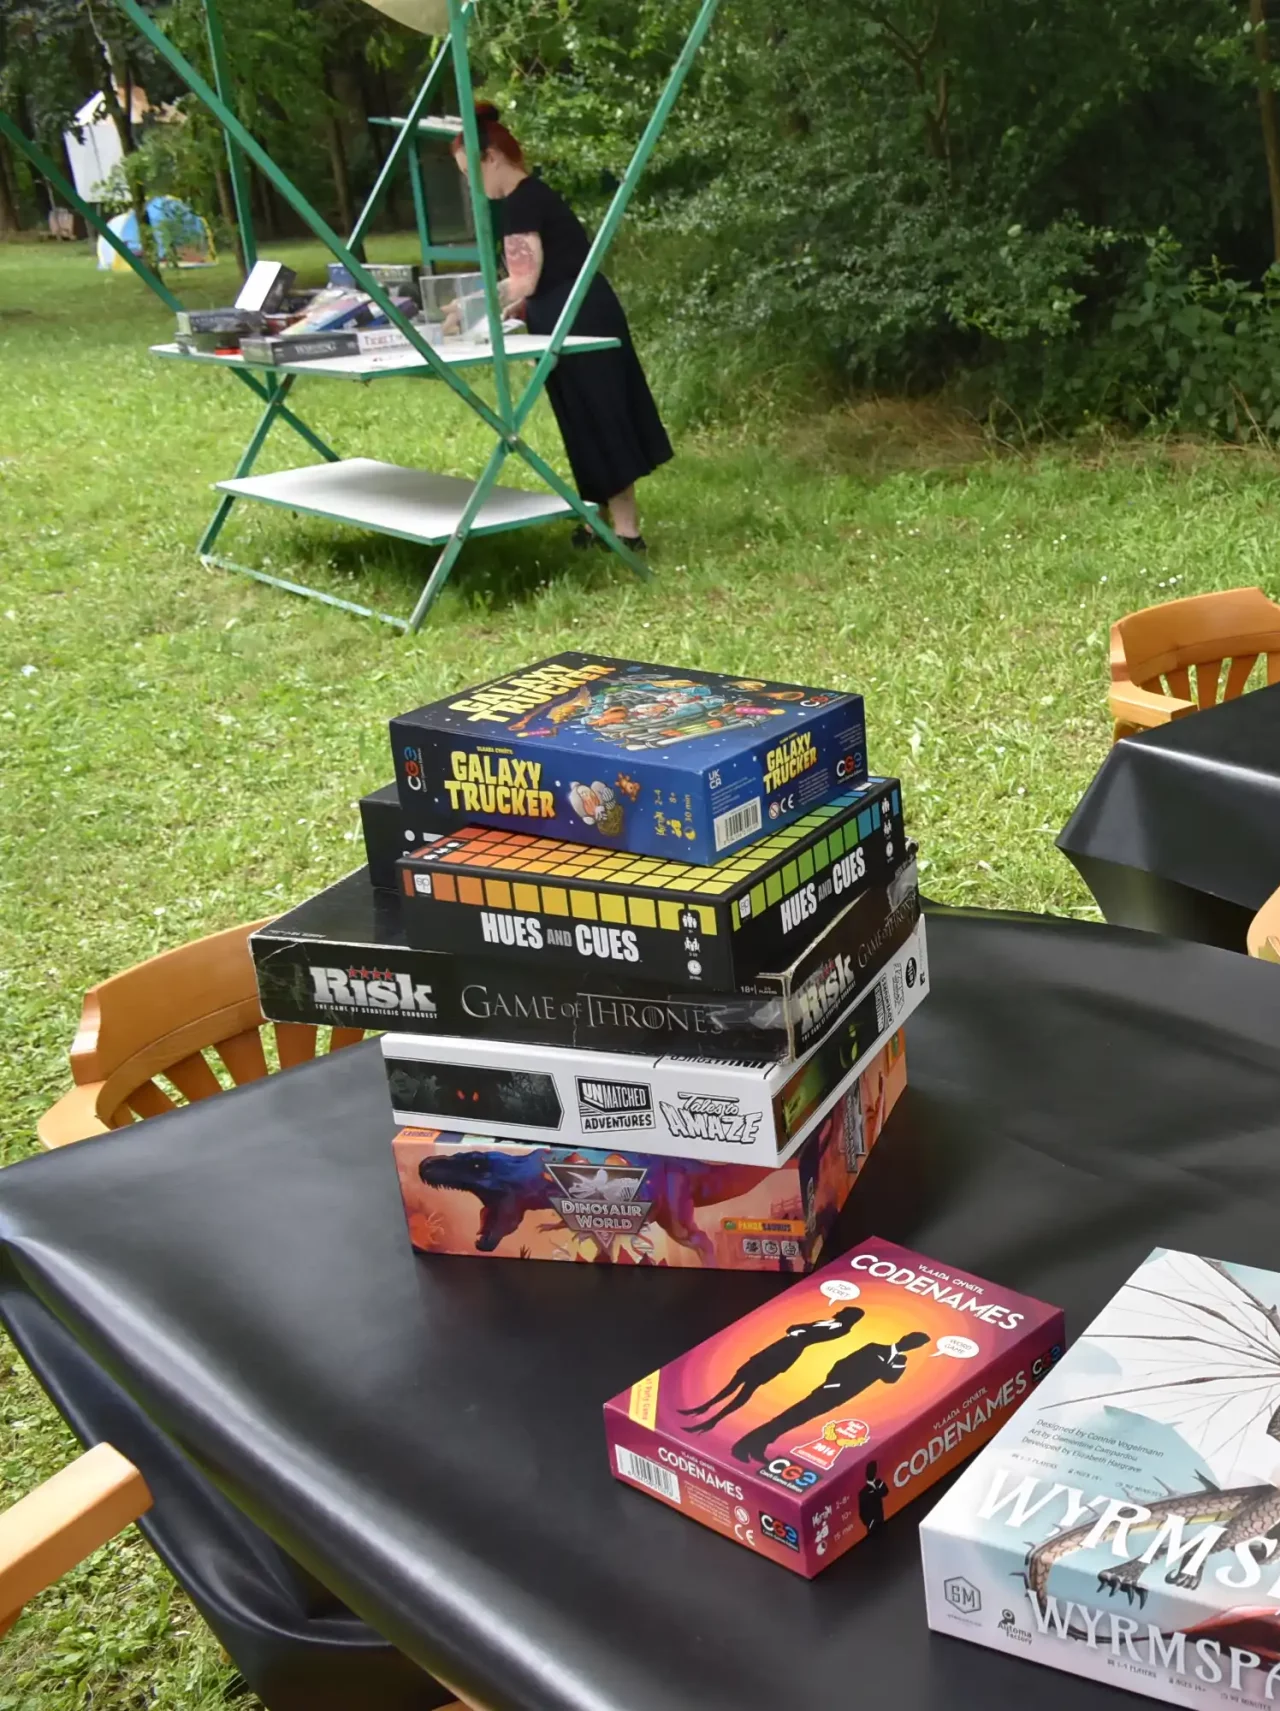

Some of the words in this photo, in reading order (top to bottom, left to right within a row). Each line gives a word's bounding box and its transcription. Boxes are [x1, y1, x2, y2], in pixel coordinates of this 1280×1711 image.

[448, 664, 578, 713] GALAXY
[467, 664, 616, 723] TRUCKER
[451, 751, 541, 790] GALAXY
[763, 746, 817, 795] TRUCKER
[766, 731, 812, 773] GALAXY
[444, 780, 556, 818] TRUCKER
[780, 882, 818, 935] HUES
[818, 877, 832, 902] AND
[832, 847, 866, 894] CUES
[480, 912, 543, 950] HUES
[547, 929, 572, 948] AND
[575, 924, 640, 963] CUES
[461, 984, 557, 1020] GAME
[576, 992, 728, 1034] THRONES
[581, 1082, 647, 1110] UNMATCHED
[584, 1114, 652, 1130] ADVENTURES
[659, 1101, 763, 1144] AMAZE
[561, 1200, 642, 1218] DINOSAUR
[575, 1214, 632, 1230] WORLD
[918, 1264, 950, 1282] VLAADA
[850, 1254, 1025, 1331] CODENAMES
[944, 1343, 966, 1355] GAME
[949, 1337, 973, 1351] WORD
[893, 1370, 1027, 1488] CODENAMES
[932, 1409, 960, 1431] VLAADA
[1028, 1428, 1042, 1436] Art
[1041, 1430, 1051, 1440] by
[1037, 1419, 1075, 1435] Designed
[1075, 1428, 1087, 1439] by
[1087, 1432, 1117, 1445] Connie
[1118, 1440, 1165, 1458] Vogelmann
[657, 1446, 744, 1501] CODENAMES
[1021, 1436, 1062, 1452] Developed
[1061, 1447, 1072, 1456] by
[1072, 1450, 1107, 1465] Elizabeth
[1108, 1458, 1143, 1474] Hargrave
[996, 1620, 1032, 1640] Automa
[1004, 1630, 1033, 1646] Factory
[1129, 1664, 1158, 1679] PLAYERS
